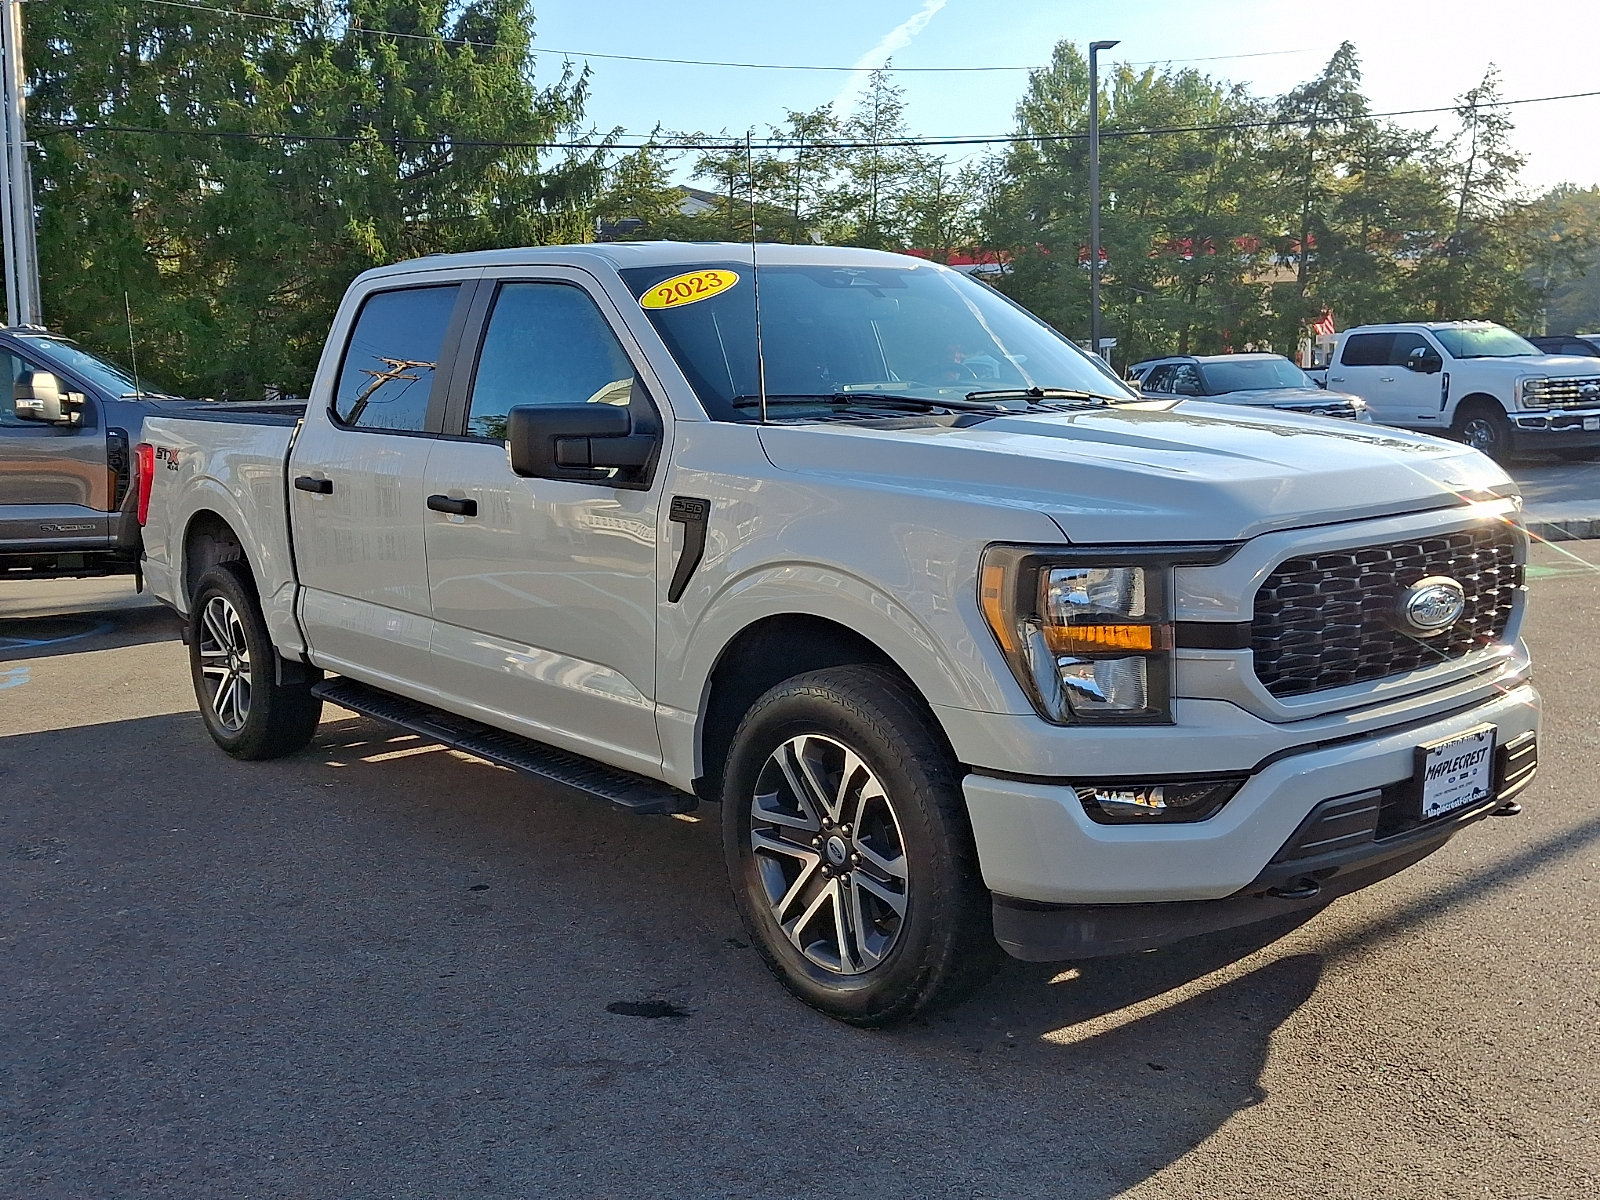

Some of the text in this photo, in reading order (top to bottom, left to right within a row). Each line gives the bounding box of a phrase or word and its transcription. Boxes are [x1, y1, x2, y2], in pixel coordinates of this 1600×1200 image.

[658, 272, 723, 304] 2023
[155, 446, 180, 465] STX
[1425, 747, 1488, 781] MAPLECREST
